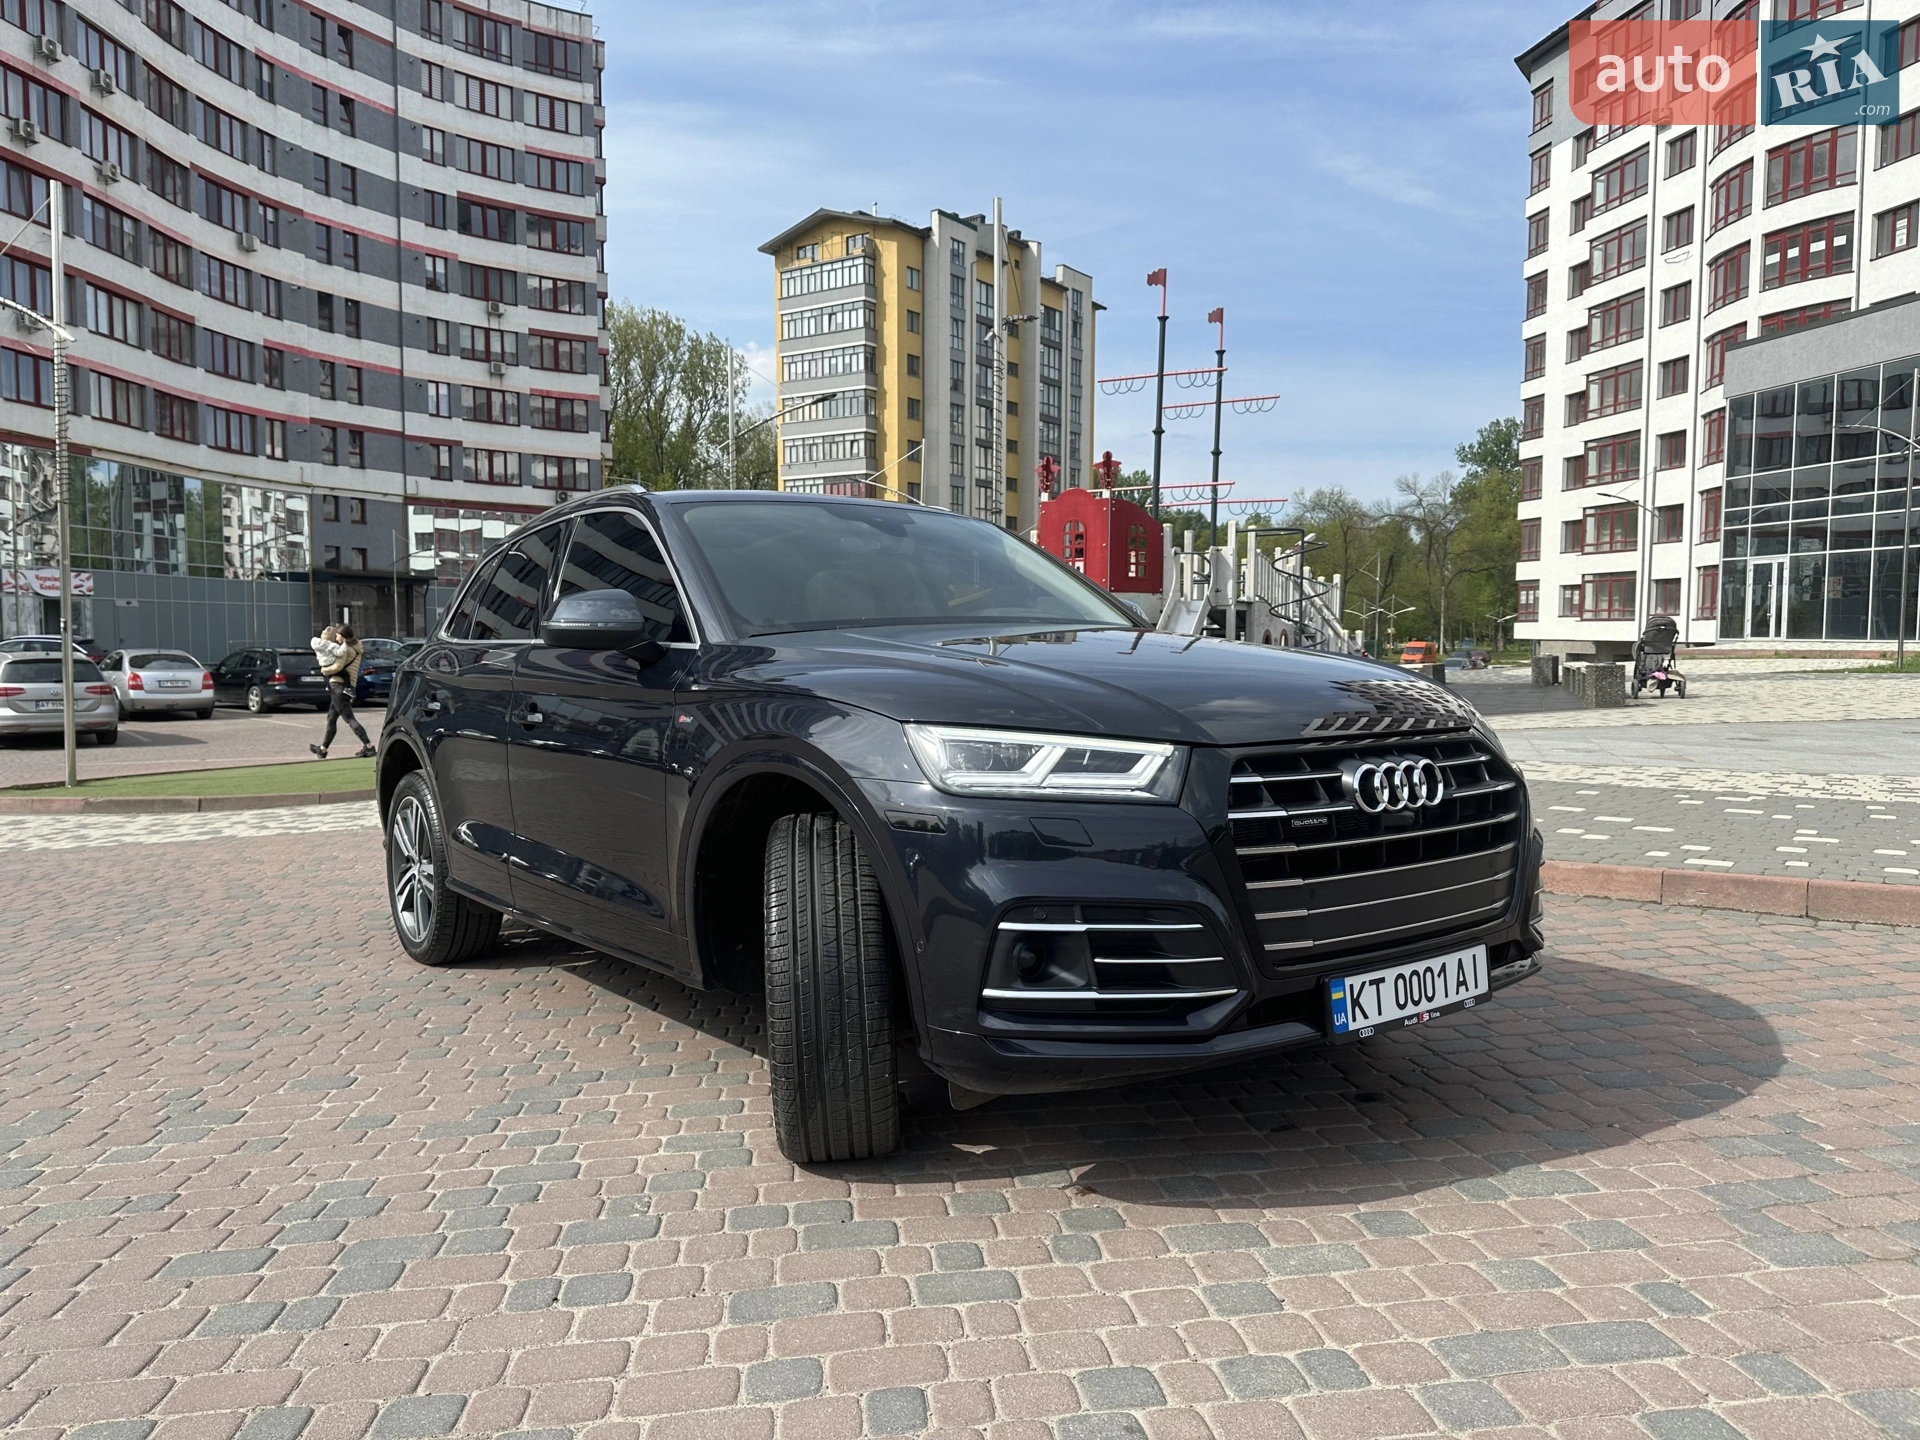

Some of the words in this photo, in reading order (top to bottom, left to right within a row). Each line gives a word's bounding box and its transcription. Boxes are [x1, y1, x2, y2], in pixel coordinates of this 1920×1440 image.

[1349, 976, 1386, 1022] KT
[1394, 961, 1449, 1010] 0001
[1334, 1012, 1347, 1026] UA
[1404, 1016, 1418, 1027] Audi
[1430, 1011, 1441, 1019] line
